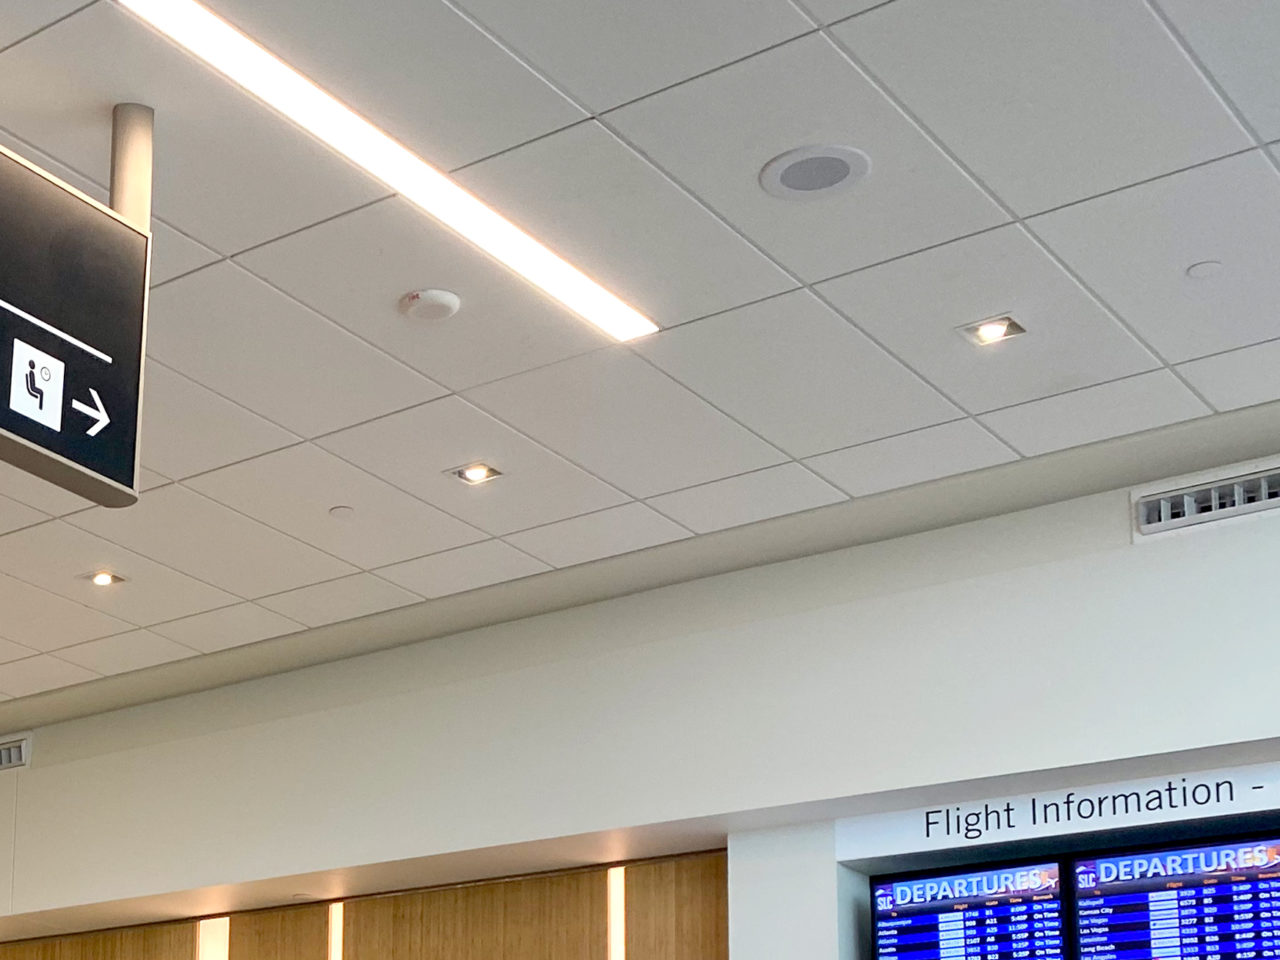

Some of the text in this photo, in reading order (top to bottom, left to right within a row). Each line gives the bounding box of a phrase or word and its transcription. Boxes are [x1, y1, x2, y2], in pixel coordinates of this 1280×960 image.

[925, 802, 1016, 839] Flight
[1031, 778, 1235, 826] Information
[1077, 845, 1267, 888] SLC DEPARTURES
[877, 868, 1041, 910] SLC DEPARTURES
[1101, 906, 1112, 914] City
[1090, 925, 1108, 934] Vegas
[1080, 943, 1114, 953] Long Beach
